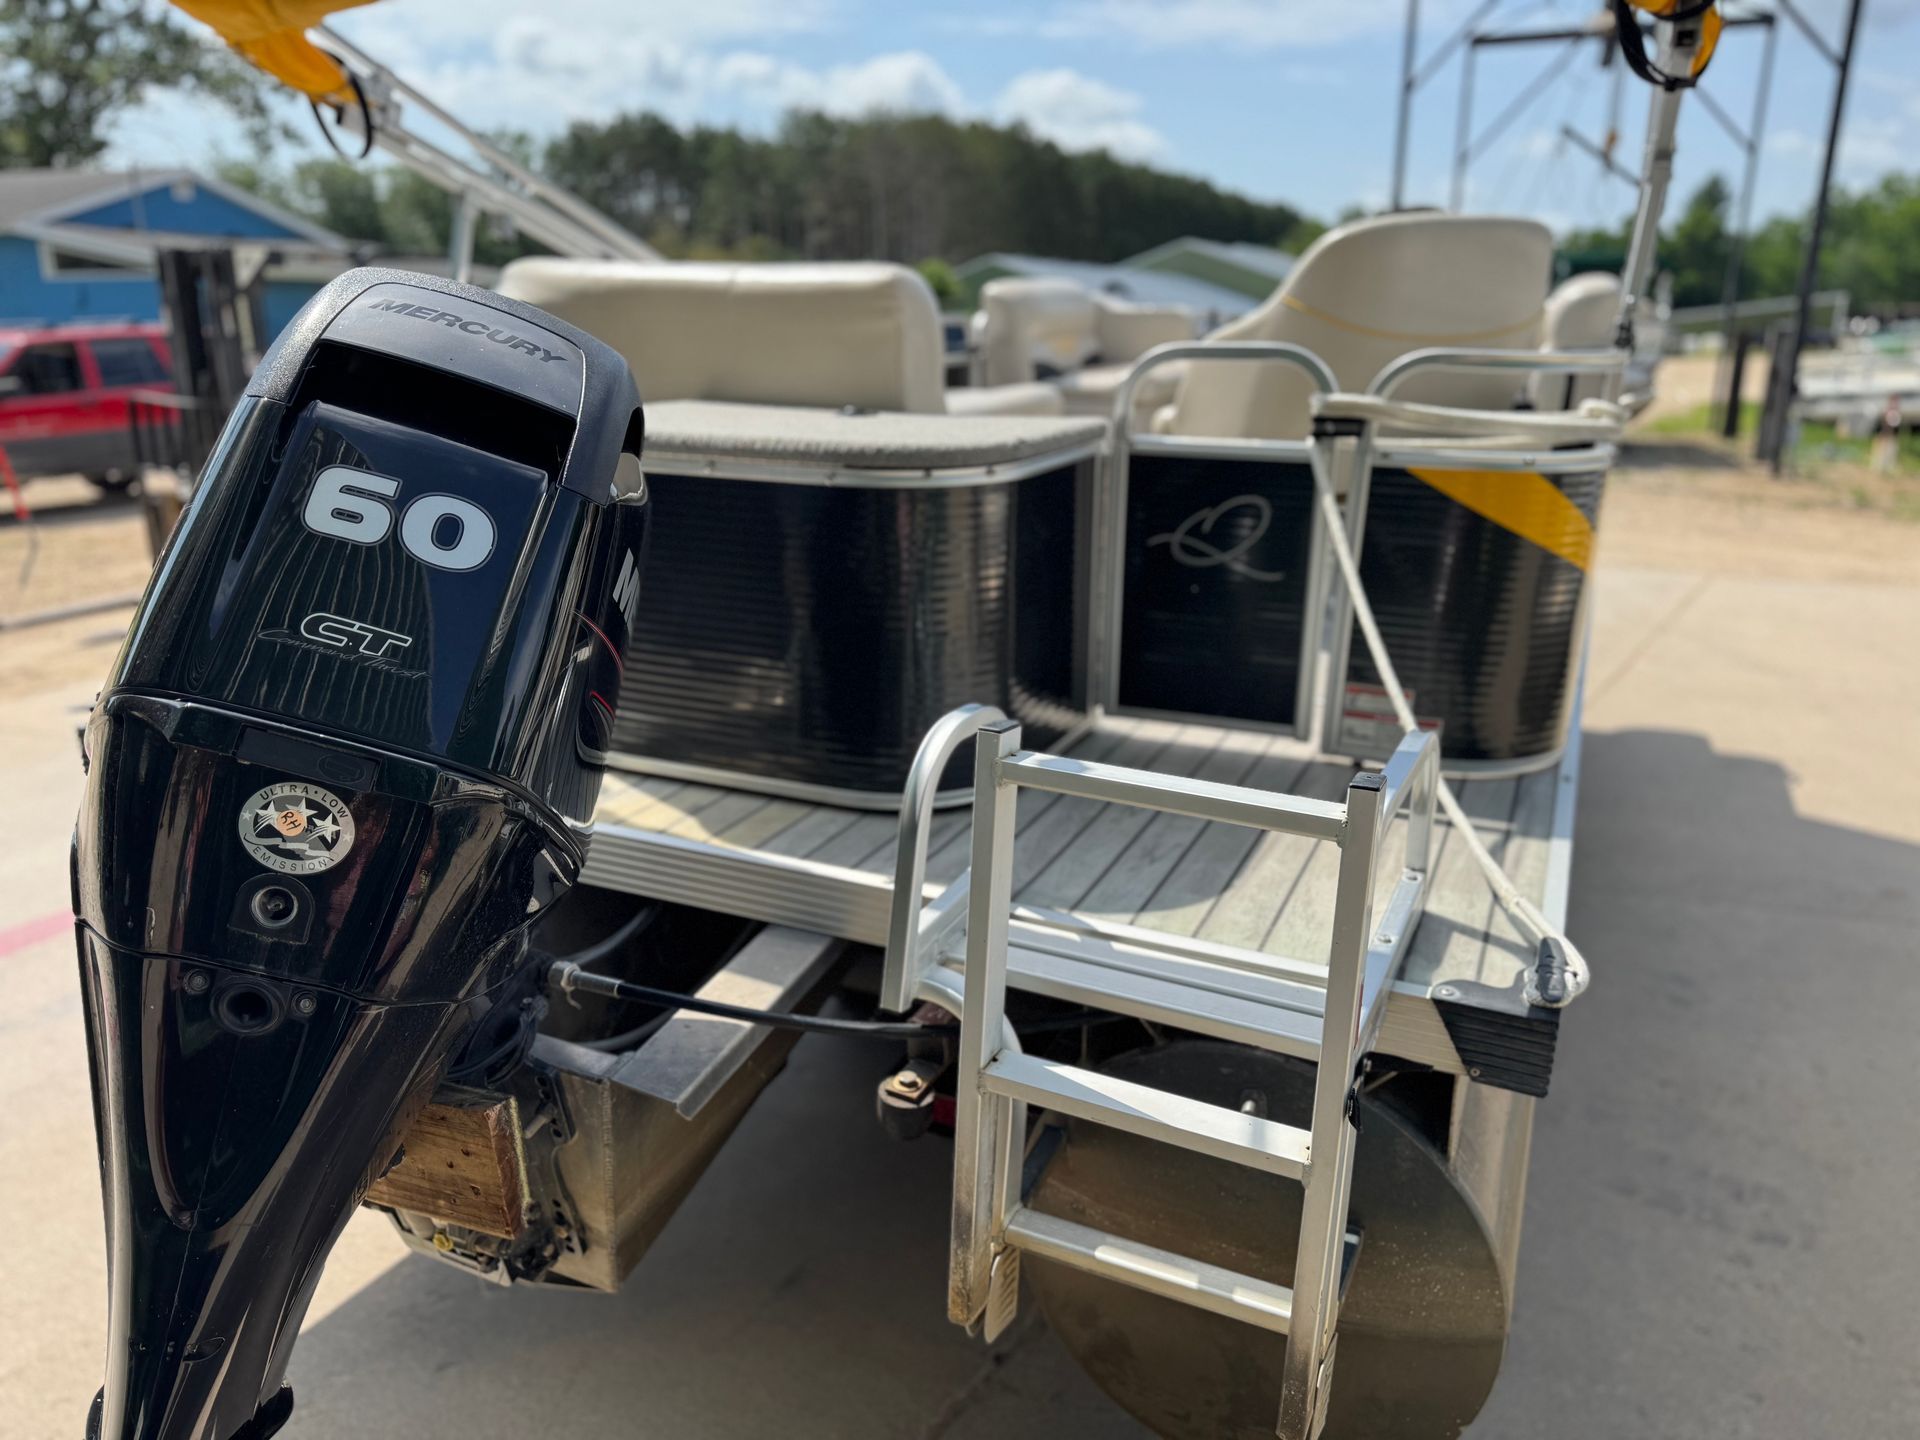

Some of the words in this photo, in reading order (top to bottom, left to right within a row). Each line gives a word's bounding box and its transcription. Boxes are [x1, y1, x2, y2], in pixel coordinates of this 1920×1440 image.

[368, 298, 569, 363] MERCURY
[300, 463, 498, 573] 60
[257, 629, 364, 662] Command
[360, 652, 433, 681] Thrust
[280, 811, 302, 831] RH
[252, 846, 328, 872] EMISSION
